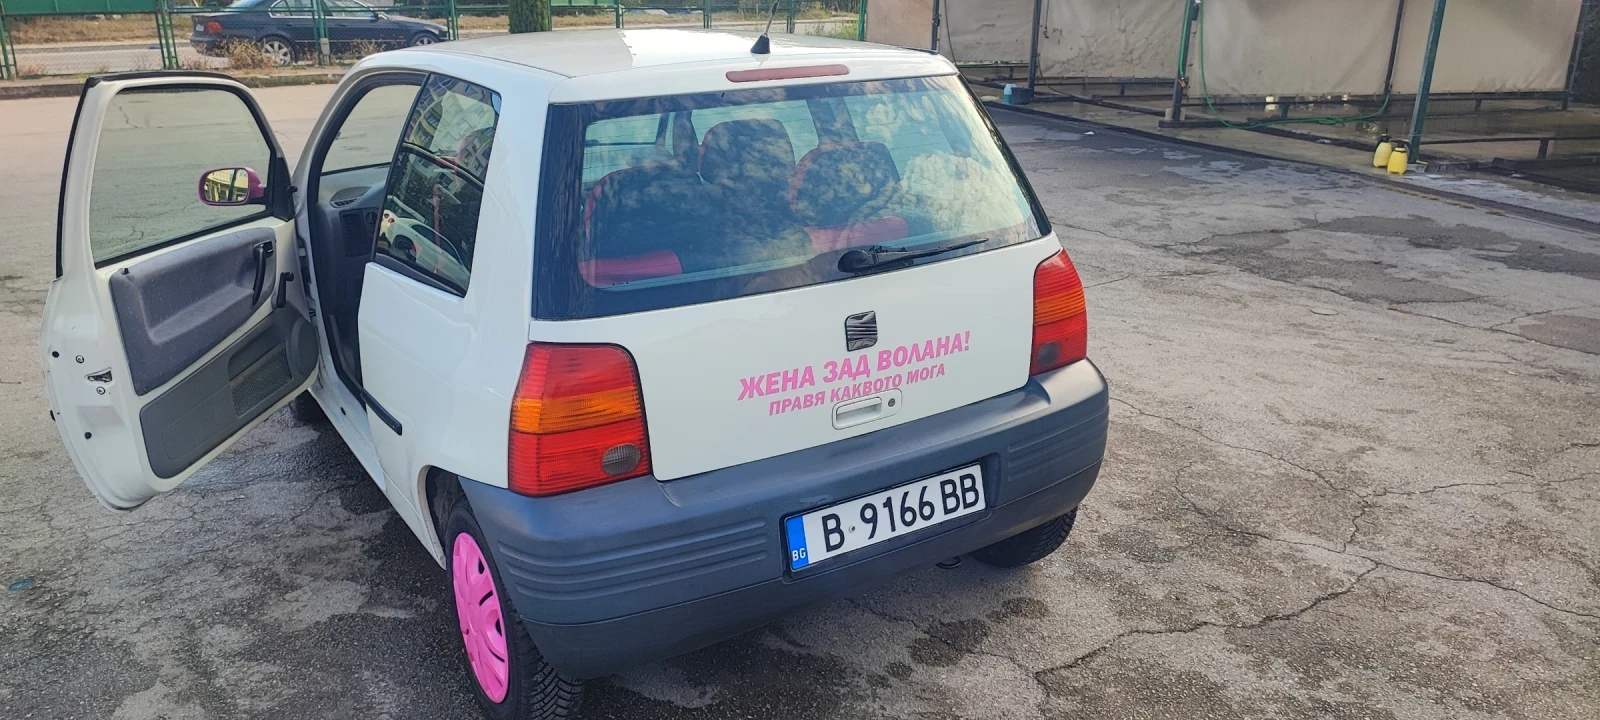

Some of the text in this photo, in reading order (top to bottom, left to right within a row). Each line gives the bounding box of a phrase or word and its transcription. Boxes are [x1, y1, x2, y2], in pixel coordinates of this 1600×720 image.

[737, 330, 971, 401] ЖЕНА ЗАД ВОЛАНА!
[768, 363, 946, 416] ПРАВЯ КАКВОТО МОГА
[859, 485, 936, 540] 9166
[791, 547, 807, 562] BG
